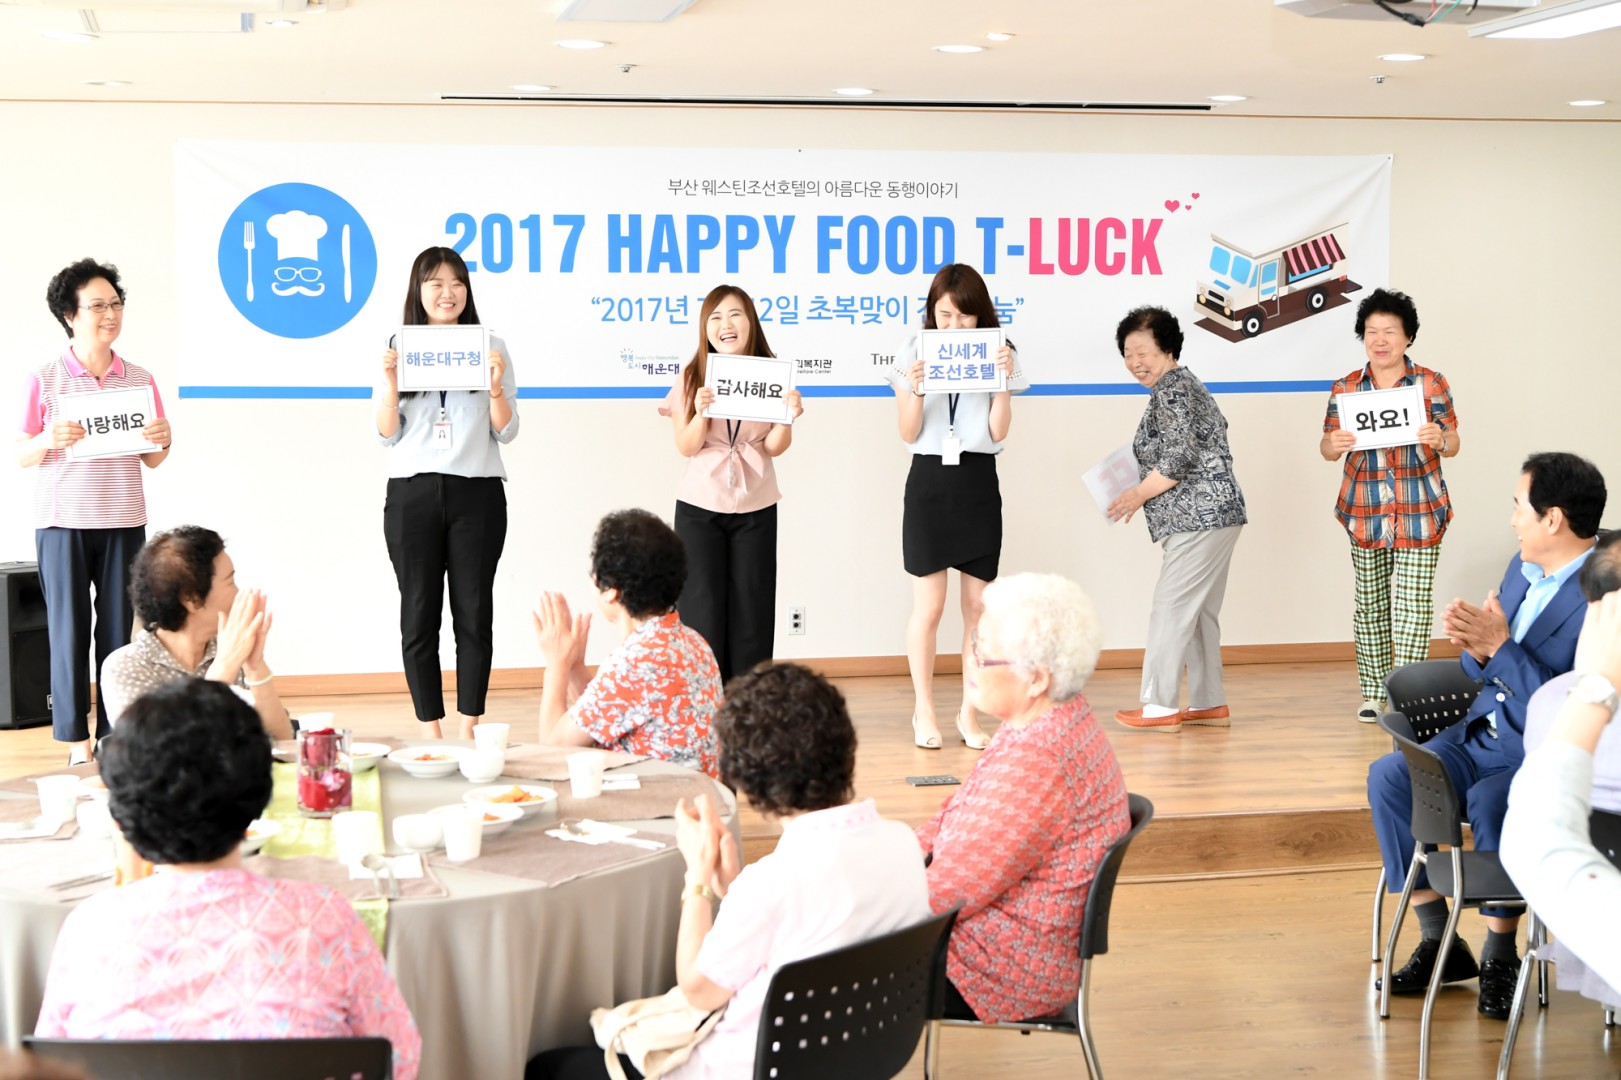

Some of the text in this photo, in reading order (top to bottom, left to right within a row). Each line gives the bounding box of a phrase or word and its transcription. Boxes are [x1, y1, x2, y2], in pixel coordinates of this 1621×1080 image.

[668, 179, 958, 199] 부산 웨스틴조선호텔의 아름다운 동행이야기
[445, 212, 1164, 276] 2017 HAPPY FOOD T-LUCK
[752, 295, 799, 325] 2일
[806, 295, 908, 325] 초복맞이
[406, 351, 481, 367] 해운대구청
[937, 342, 987, 360] 신세계
[928, 363, 995, 381] 조선호텔
[716, 379, 783, 399] 감사해요
[1355, 408, 1410, 432] 와요!
